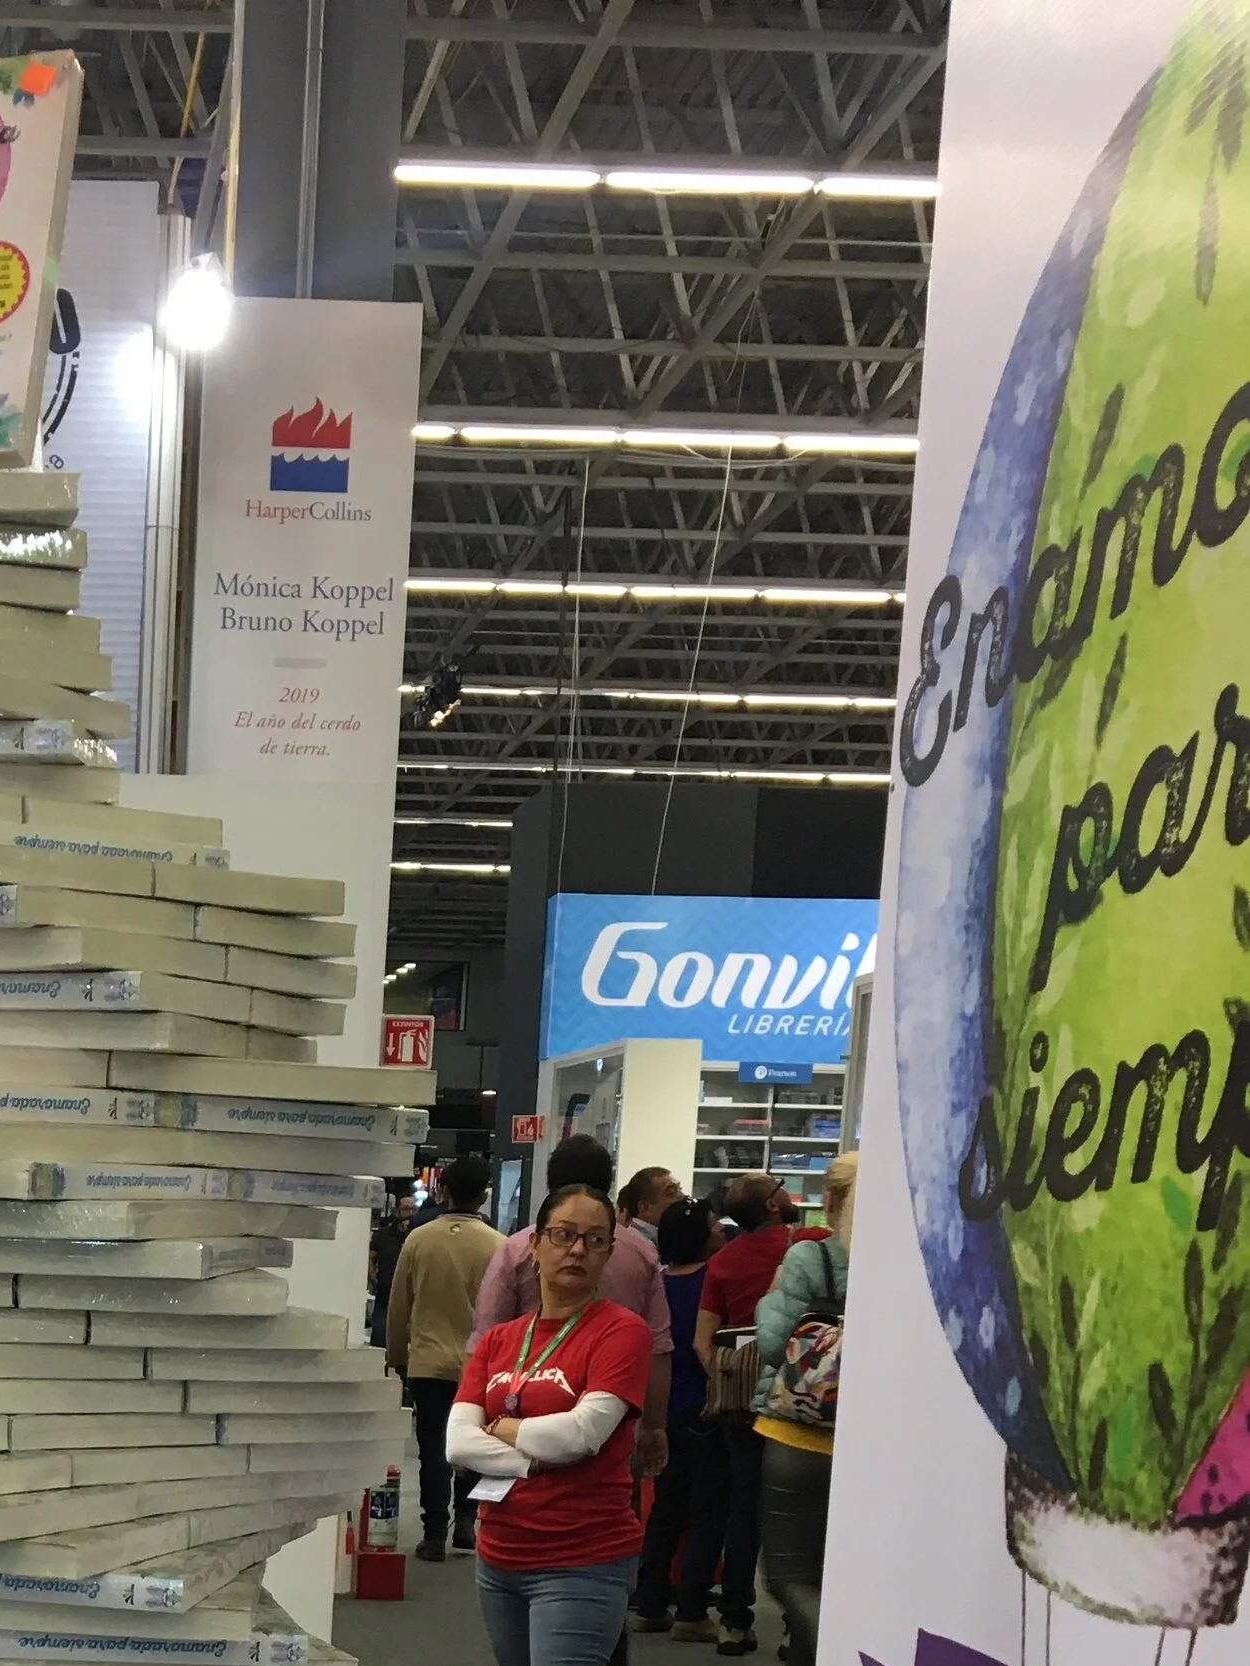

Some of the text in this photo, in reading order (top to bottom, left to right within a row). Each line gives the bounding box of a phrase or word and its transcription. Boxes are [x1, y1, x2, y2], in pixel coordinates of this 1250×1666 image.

[245, 499, 372, 522] HarperCollins
[214, 571, 395, 609] Mónica Koppel
[220, 606, 385, 642] Bruno Koppel
[279, 686, 321, 704] 2019
[234, 711, 361, 732] El año del cerdo
[259, 739, 331, 757] de tierra.
[10, 1095, 90, 1113] Enamorada
[278, 1109, 306, 1124] para
[88, 1635, 128, 1652] para
